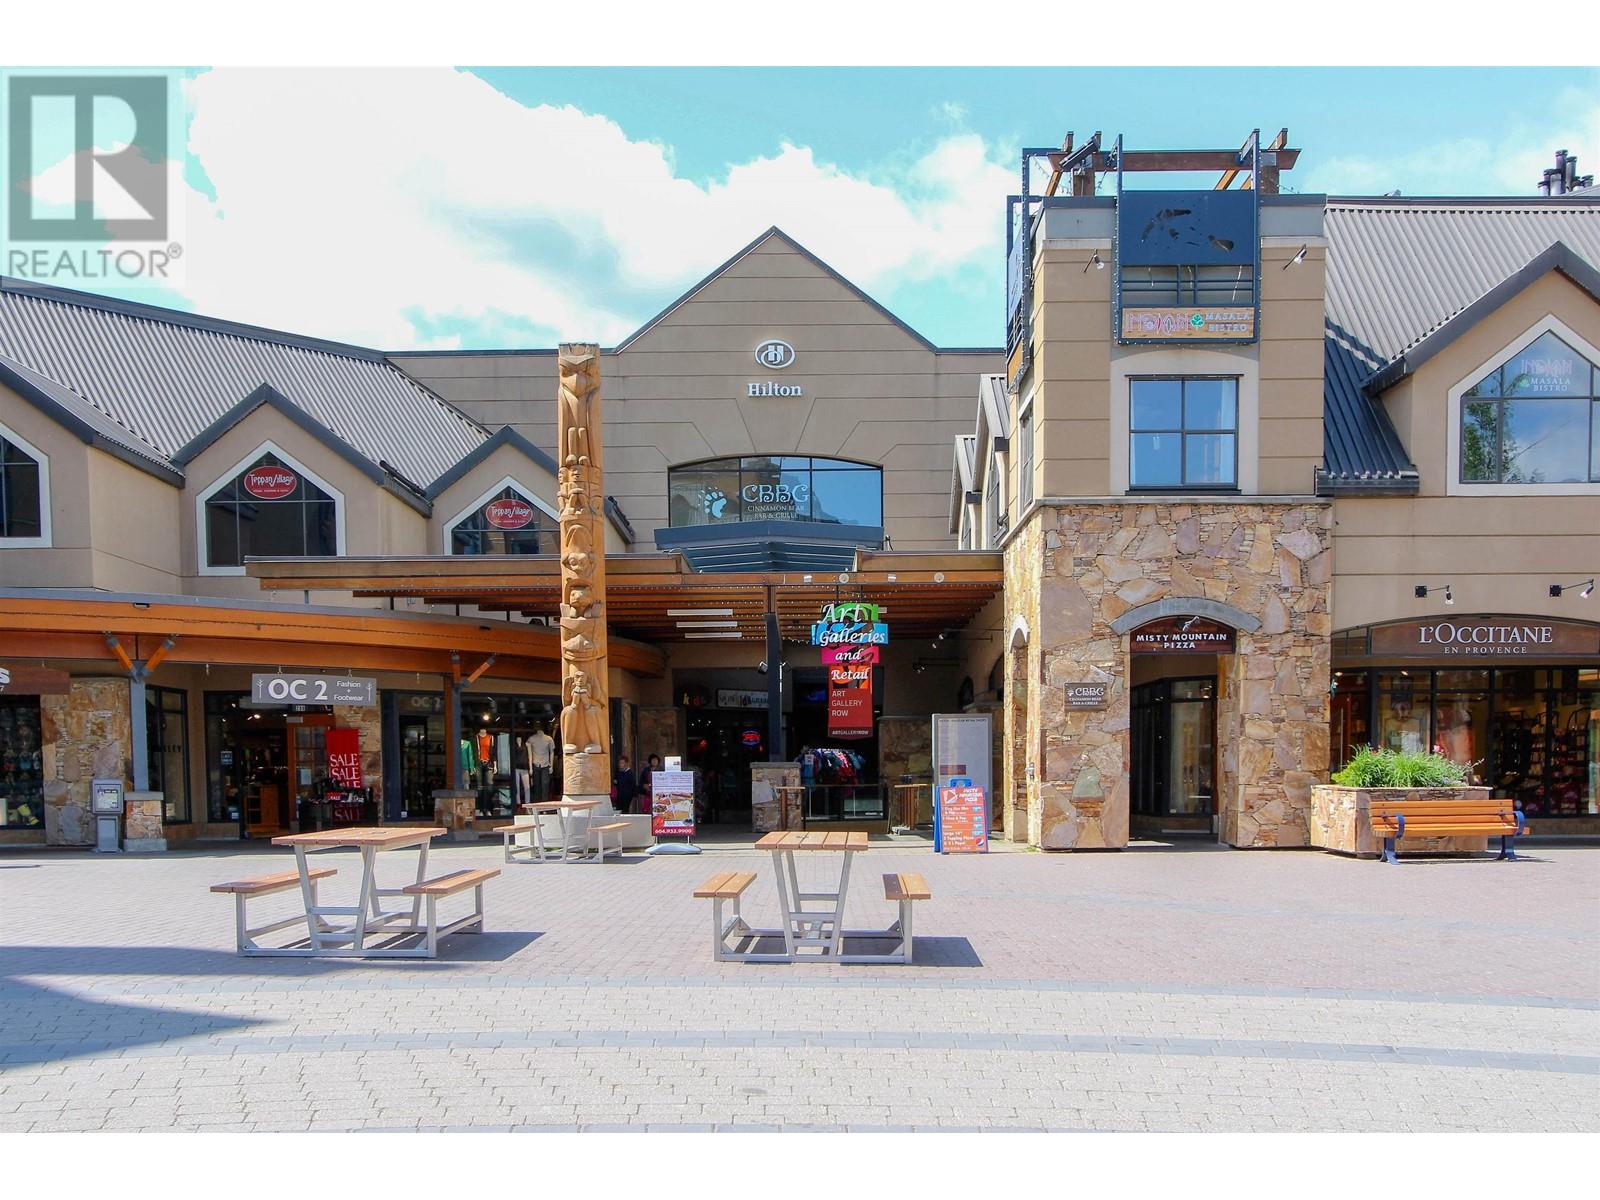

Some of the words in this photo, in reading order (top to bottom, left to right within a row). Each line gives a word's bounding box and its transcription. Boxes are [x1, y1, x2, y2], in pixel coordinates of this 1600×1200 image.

[1208, 324, 1249, 332] BISTRO
[1531, 377, 1571, 385] MASALA
[748, 381, 802, 397] Hilton
[742, 484, 810, 503] CBBG
[816, 603, 864, 624] Art
[820, 628, 885, 647] Galleries
[1172, 633, 1227, 641] MOUNTAIN
[835, 649, 864, 661] and
[831, 667, 871, 680] Retail
[268, 679, 307, 700] OC
[314, 680, 328, 700] 2
[336, 680, 361, 688] Fashion
[1075, 687, 1104, 696] CBBG
[333, 694, 364, 702] Footwear
[329, 754, 359, 768] SALE
[331, 768, 361, 780] SALE
